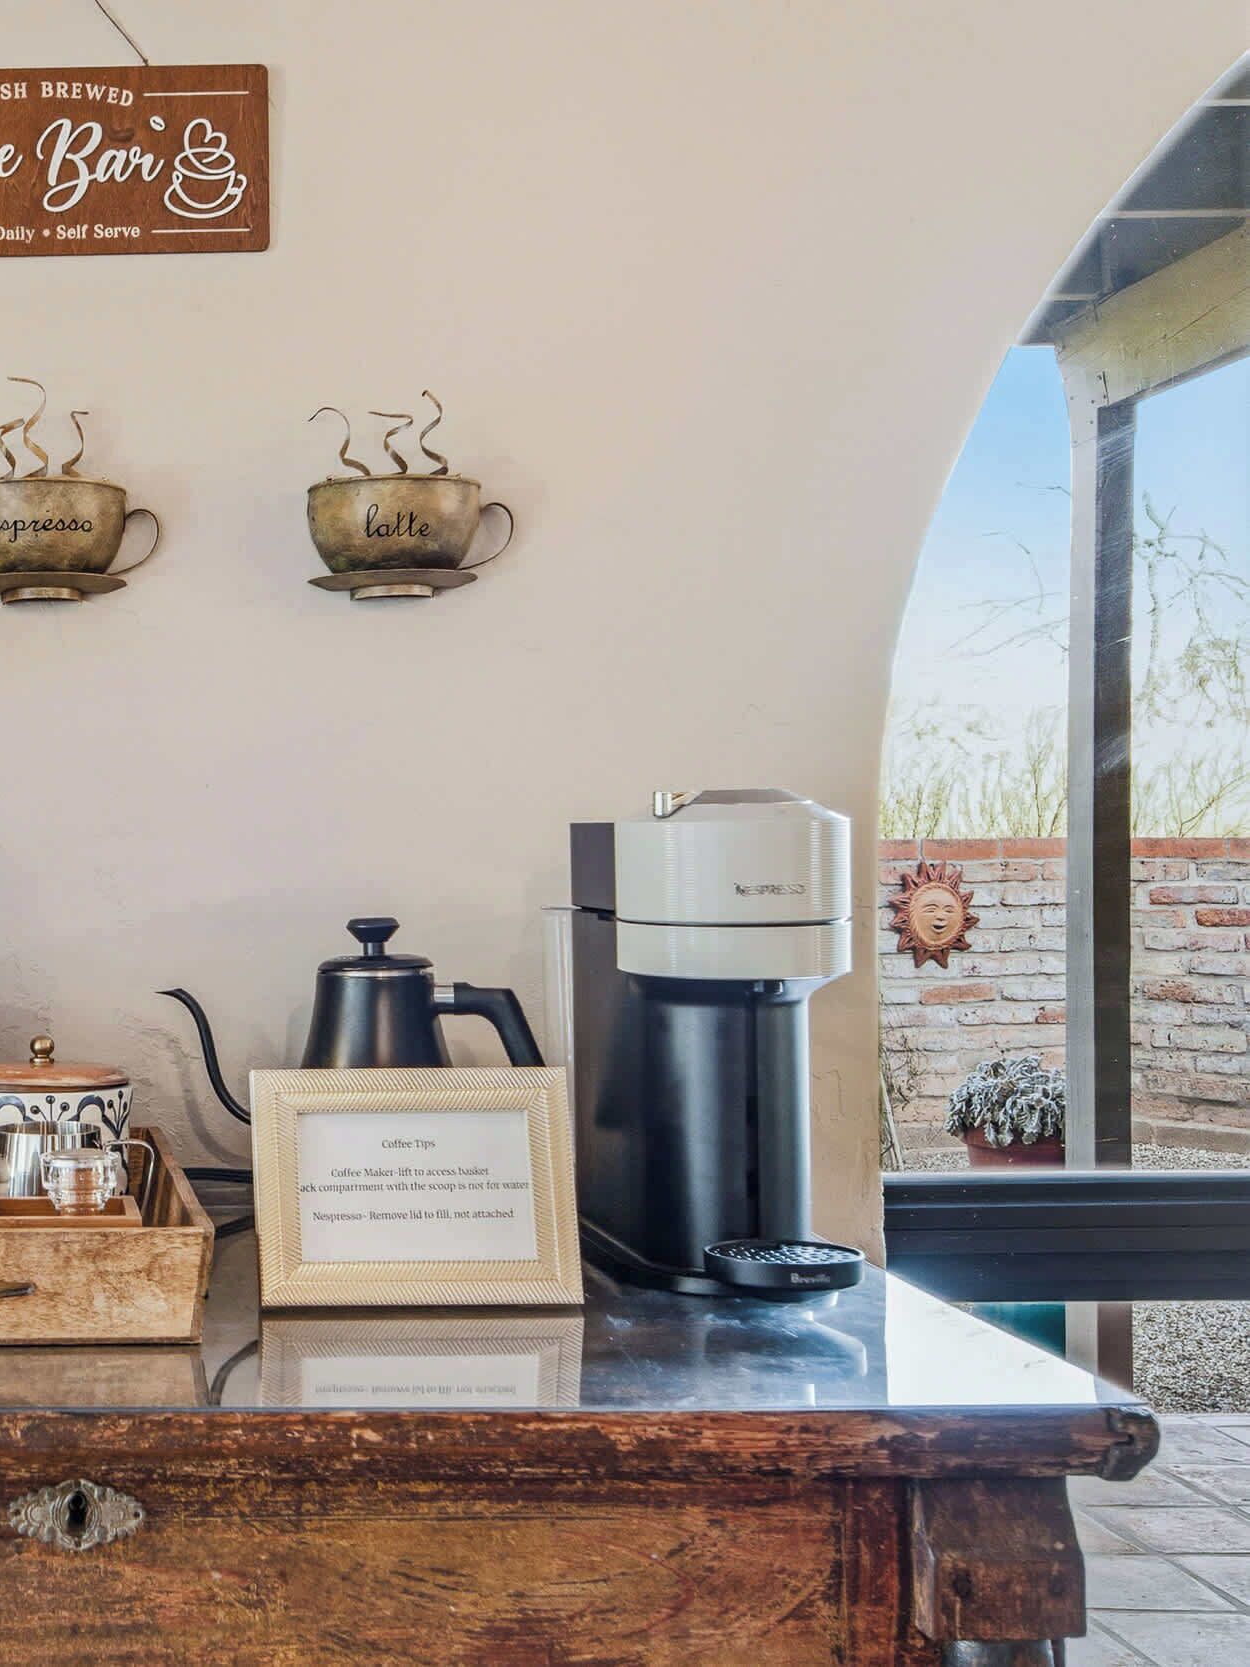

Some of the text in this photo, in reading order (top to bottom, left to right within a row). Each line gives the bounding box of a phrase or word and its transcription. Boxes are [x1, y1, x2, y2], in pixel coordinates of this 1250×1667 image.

[40, 81, 134, 107] BREWED
[36, 118, 166, 212] Bar
[56, 223, 88, 239] Self
[93, 223, 141, 239] Serve
[364, 503, 432, 538] latte
[381, 1138, 436, 1150] Coffee Tips
[331, 1167, 362, 1177] Coffee
[414, 1168, 425, 1177] to
[426, 1168, 456, 1176] access
[458, 1166, 489, 1176] basket
[318, 1183, 384, 1194] compartment
[385, 1181, 408, 1192] with
[410, 1181, 427, 1192] the
[428, 1183, 456, 1193] scoop
[458, 1181, 466, 1190] is
[468, 1182, 484, 1190] not
[486, 1180, 500, 1190] for
[502, 1182, 530, 1190] water
[369, 1210, 408, 1220] Remove
[409, 1209, 423, 1220] lid
[424, 1210, 434, 1219] to
[454, 1210, 470, 1219] not
[472, 1208, 515, 1219] attached
